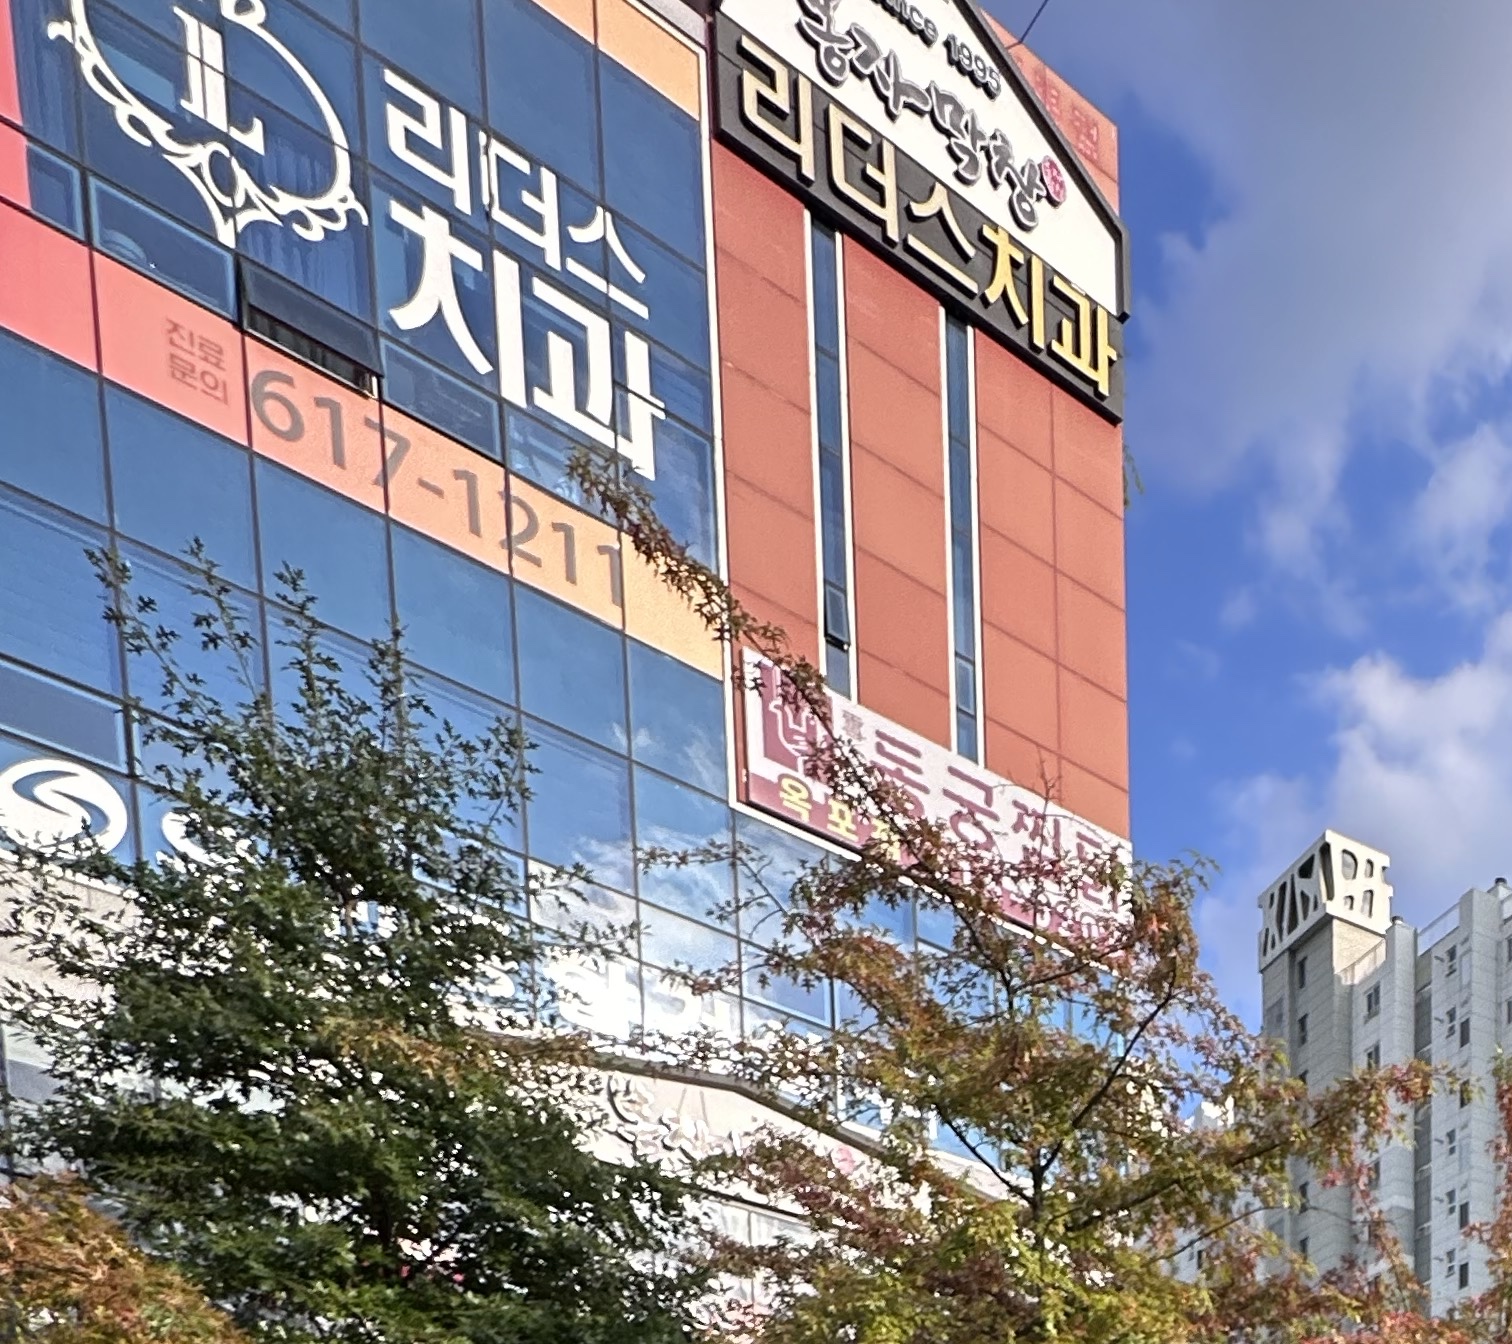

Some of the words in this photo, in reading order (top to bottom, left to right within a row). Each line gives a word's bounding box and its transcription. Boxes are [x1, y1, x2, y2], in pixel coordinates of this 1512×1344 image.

[944, 33, 1001, 99] 1995
[384, 68, 649, 321] 리더스
[166, 317, 227, 372] 진료
[169, 352, 229, 406] 문의
[387, 199, 667, 482] 치과
[251, 369, 623, 608] 617-1211
